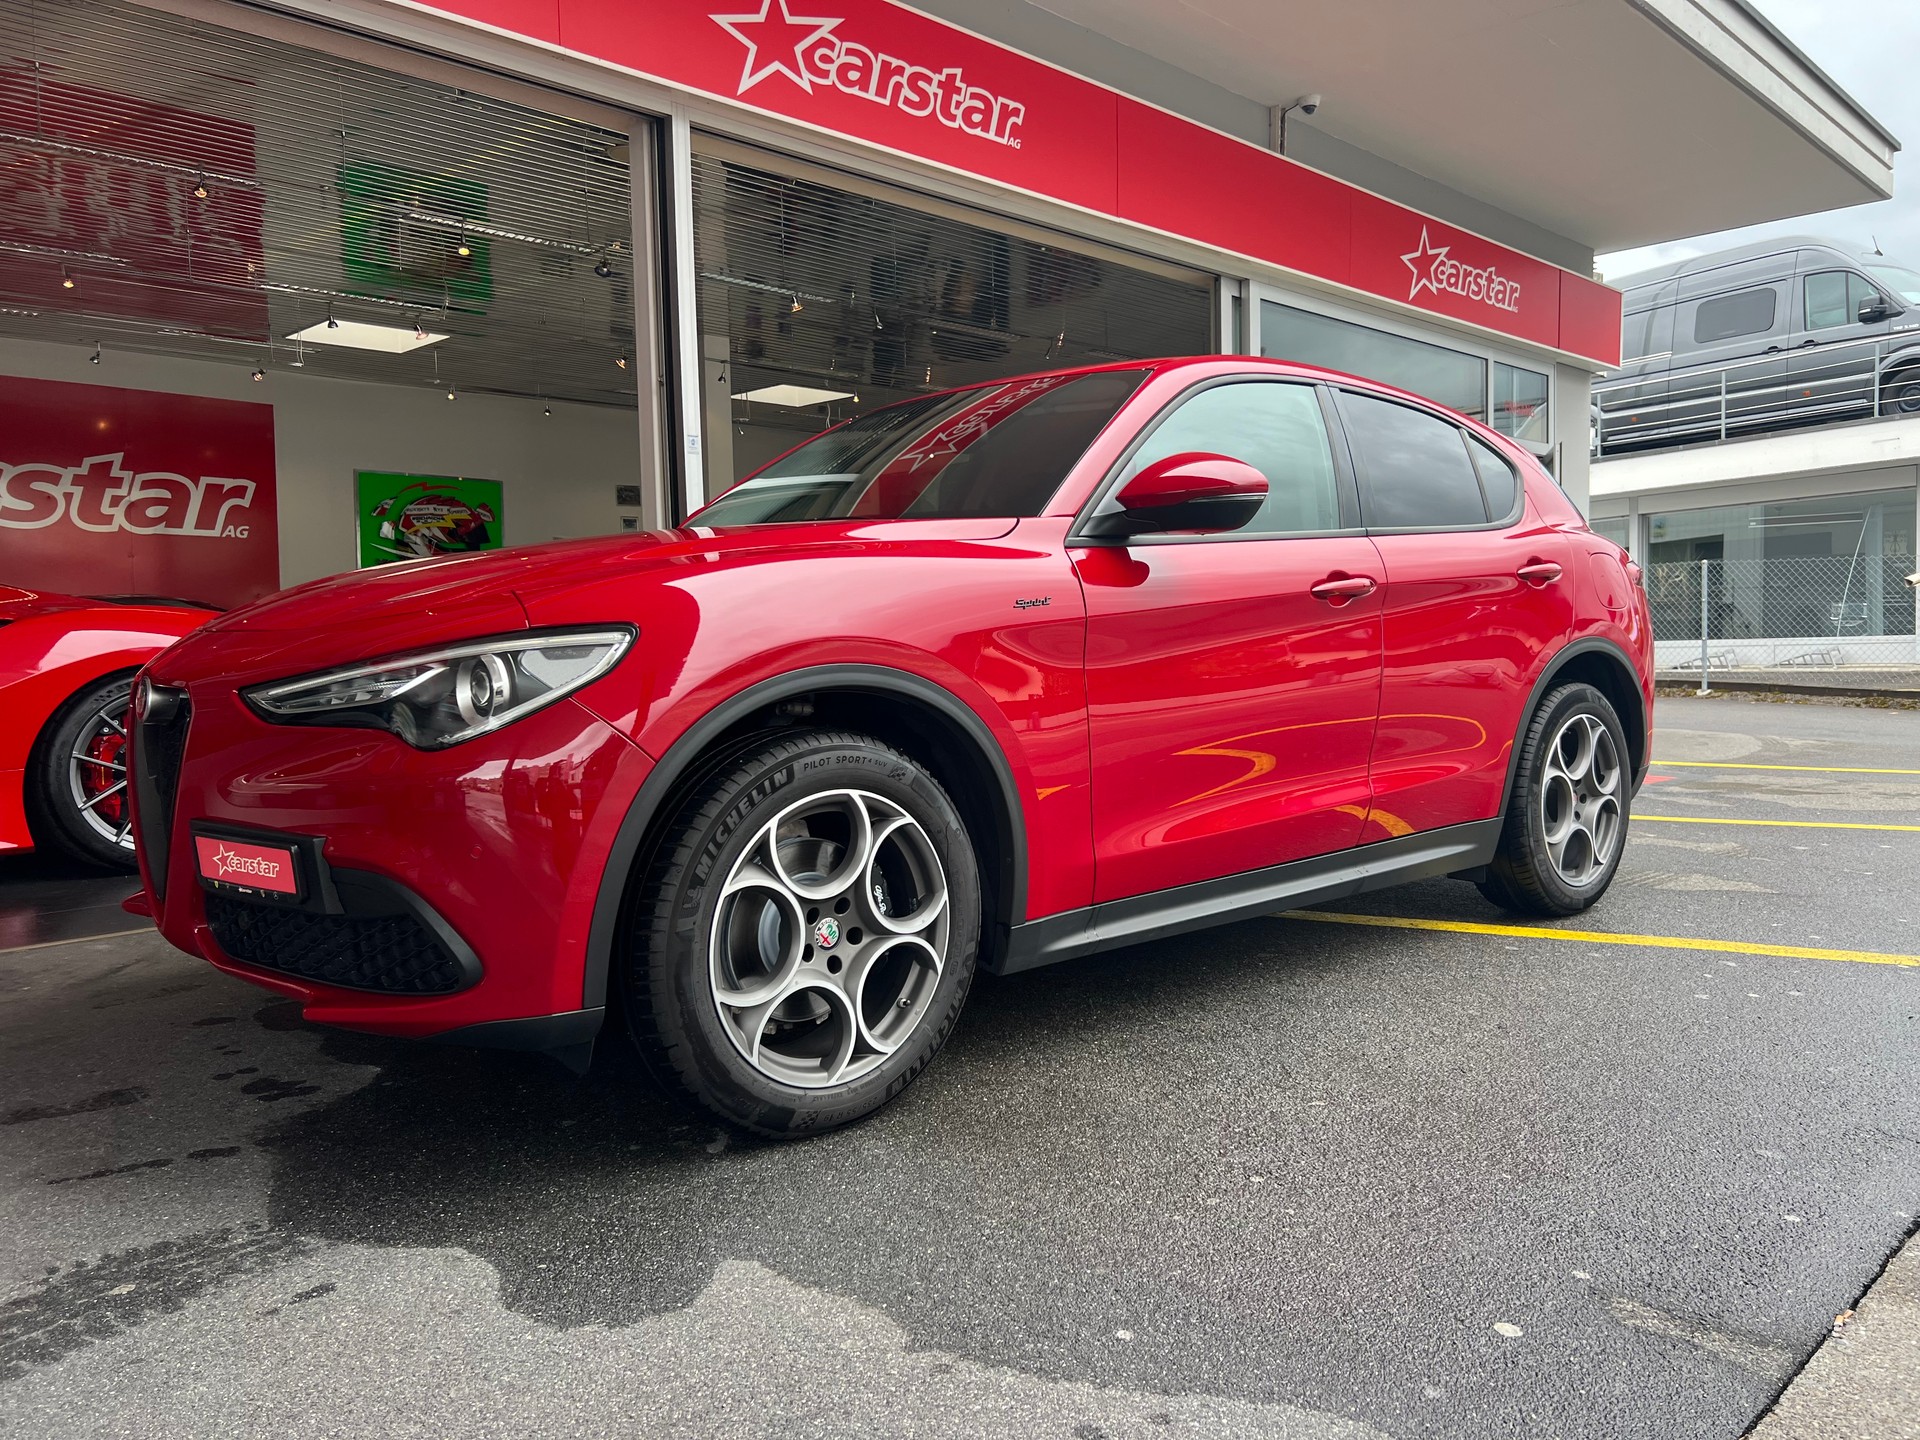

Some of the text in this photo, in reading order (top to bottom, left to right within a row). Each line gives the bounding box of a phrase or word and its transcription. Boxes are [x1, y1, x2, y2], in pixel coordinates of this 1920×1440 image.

[799, 32, 1026, 149] carstar AG
[1432, 256, 1520, 311] carstar
[0, 452, 256, 539] star AG
[695, 768, 790, 881] MICHELIN
[803, 756, 832, 772] PILOT
[835, 755, 868, 765] SPORT
[874, 759, 888, 768] SUV
[228, 854, 280, 878] carstar
